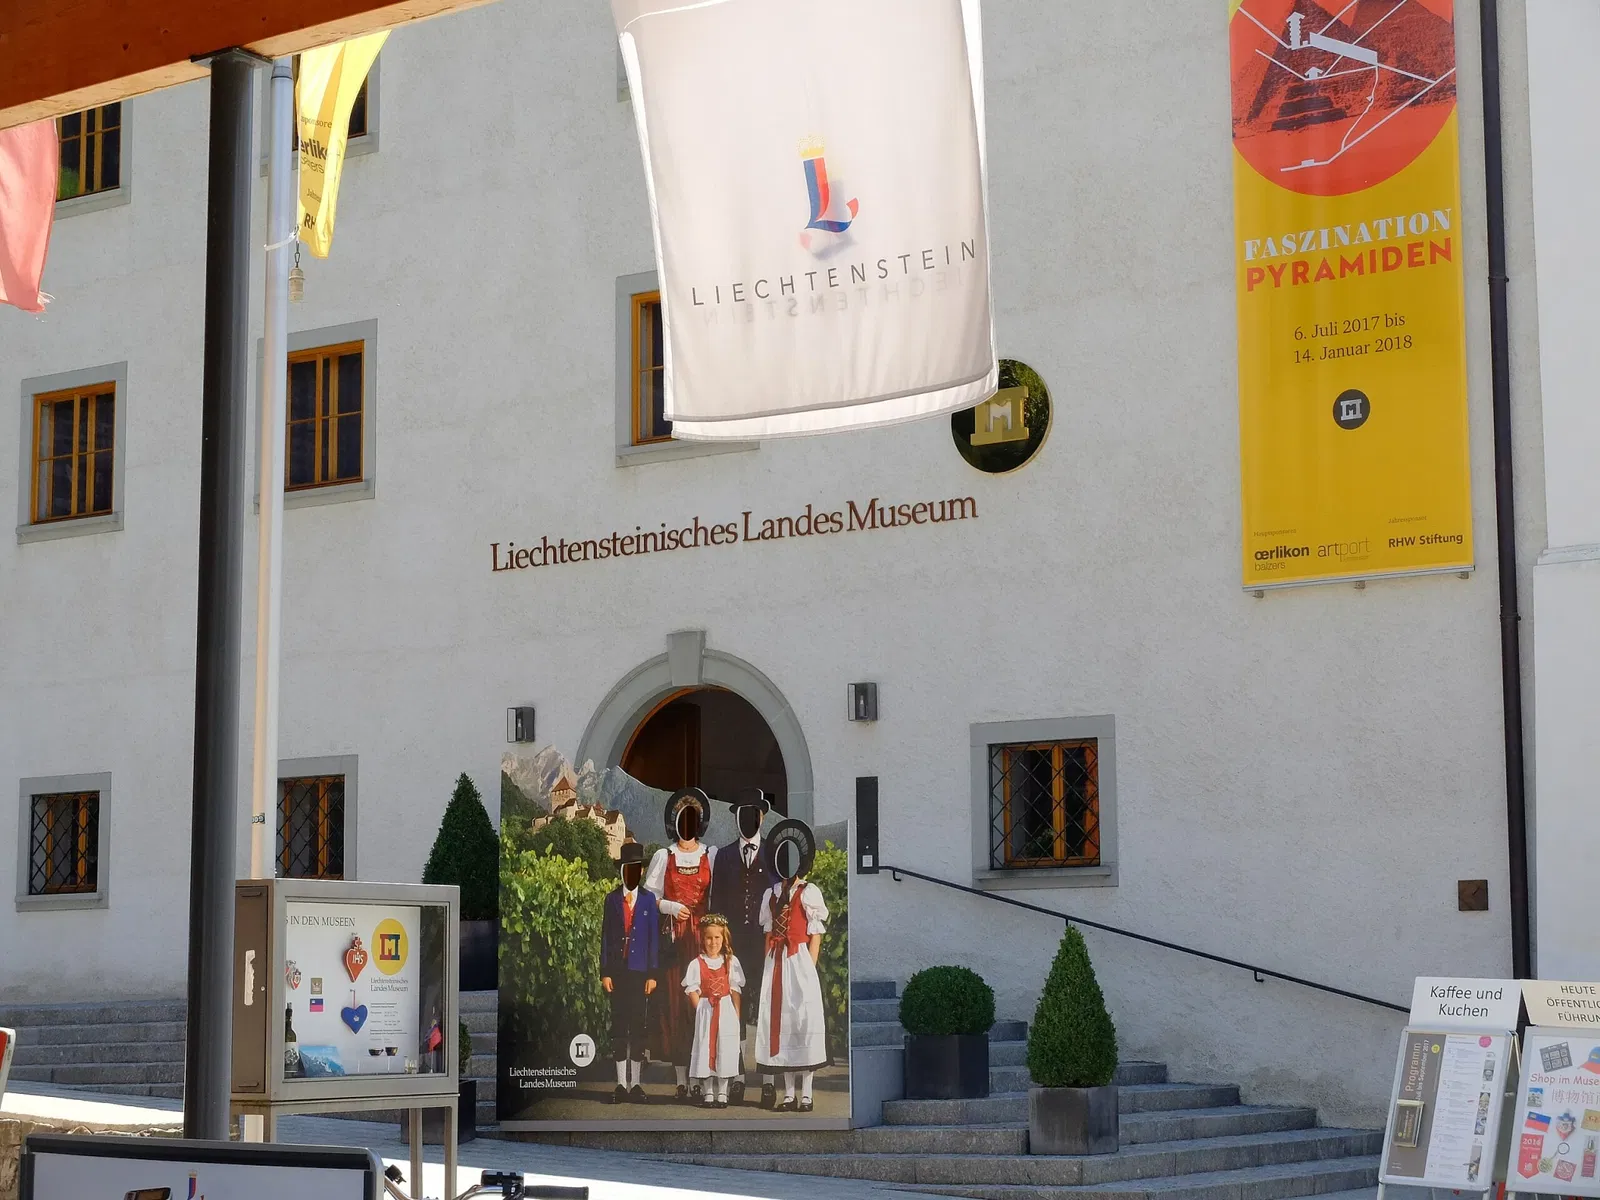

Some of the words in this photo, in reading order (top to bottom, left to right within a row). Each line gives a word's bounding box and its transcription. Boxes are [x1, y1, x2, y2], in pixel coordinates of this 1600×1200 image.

[1244, 208, 1452, 261] FASZINATION
[691, 238, 977, 306] LIECHTENSTEIN
[1245, 237, 1453, 292] PYRAMIDEN
[1294, 326, 1307, 342] 6.
[1311, 321, 1338, 339] Juli
[1343, 315, 1380, 335] 2017
[1385, 312, 1406, 329] bis
[1294, 349, 1315, 365] 14.
[1320, 343, 1371, 361] Januar
[1375, 334, 1413, 353] 2018
[490, 516, 739, 571] Liechtensteinisches
[1388, 537, 1416, 549] RHW
[1419, 533, 1464, 546] Stiftung
[1254, 561, 1286, 572] balzers
[290, 915, 300, 925] IN
[302, 915, 320, 926] DEN
[321, 917, 356, 927] MUSEEN
[1430, 985, 1471, 1000] Kaffee
[1476, 987, 1503, 1001] und
[1560, 984, 1597, 996] HEUTE
[1438, 1003, 1489, 1017] Kuchen
[509, 1066, 576, 1077] Liechtensteinisches
[1405, 1042, 1421, 1092] Programm
[1530, 1073, 1556, 1087] Shop
[1558, 1074, 1571, 1085] im
